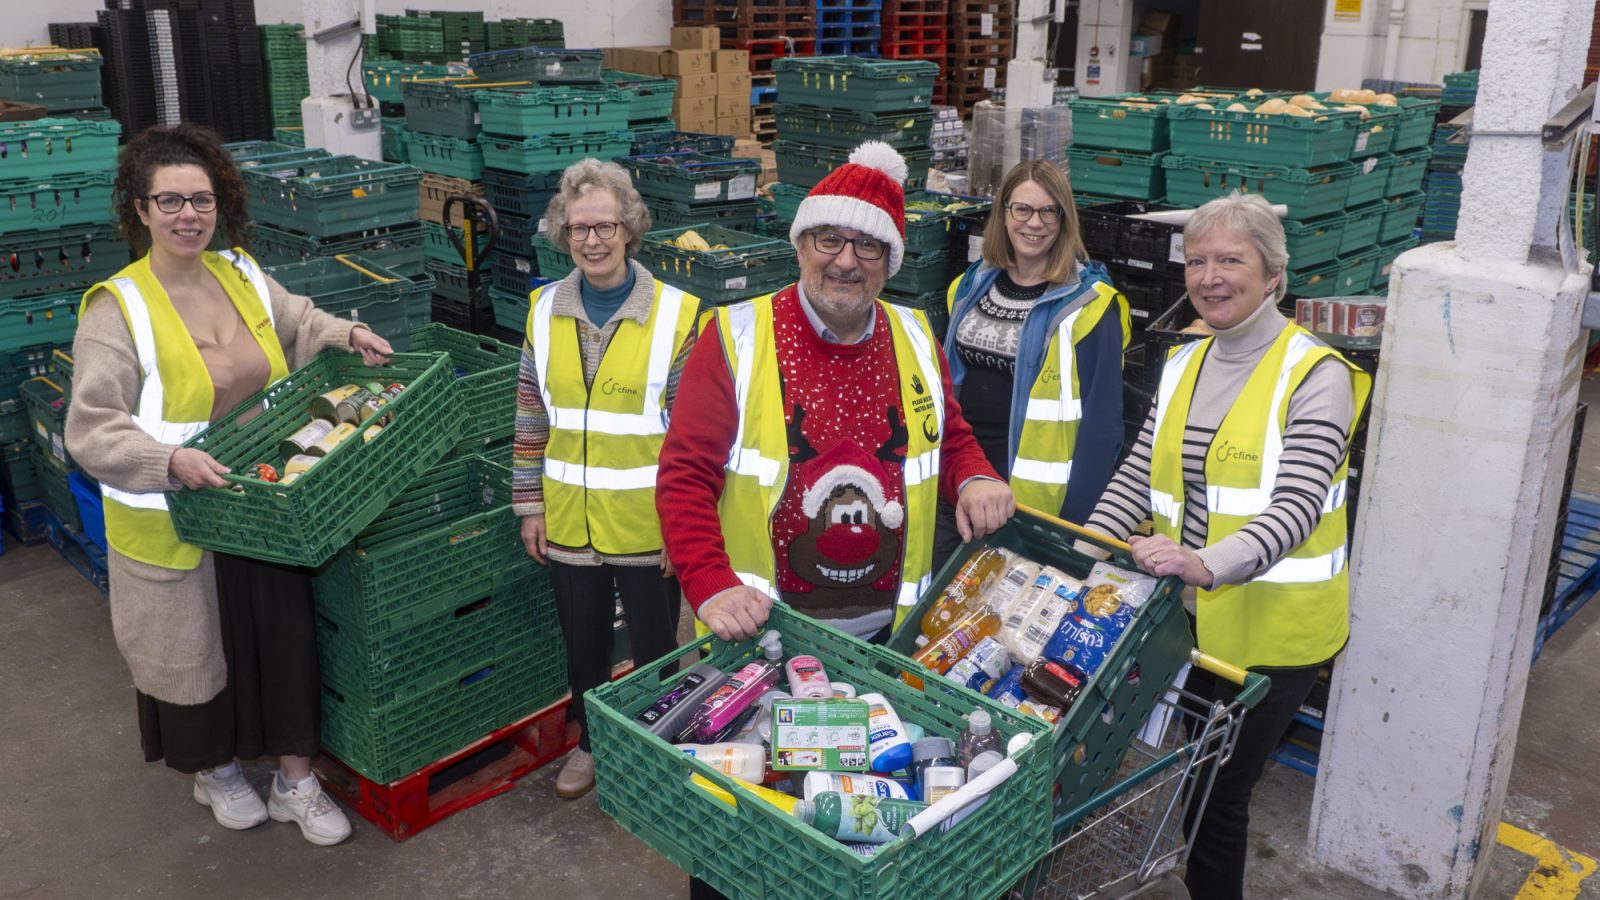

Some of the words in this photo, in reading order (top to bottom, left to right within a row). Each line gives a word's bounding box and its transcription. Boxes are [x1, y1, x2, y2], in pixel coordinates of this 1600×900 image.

[618, 386, 637, 395] cfine
[1233, 451, 1256, 461] cfine
[1060, 620, 1104, 647] FUSILLI
[871, 730, 895, 741] Sanex
